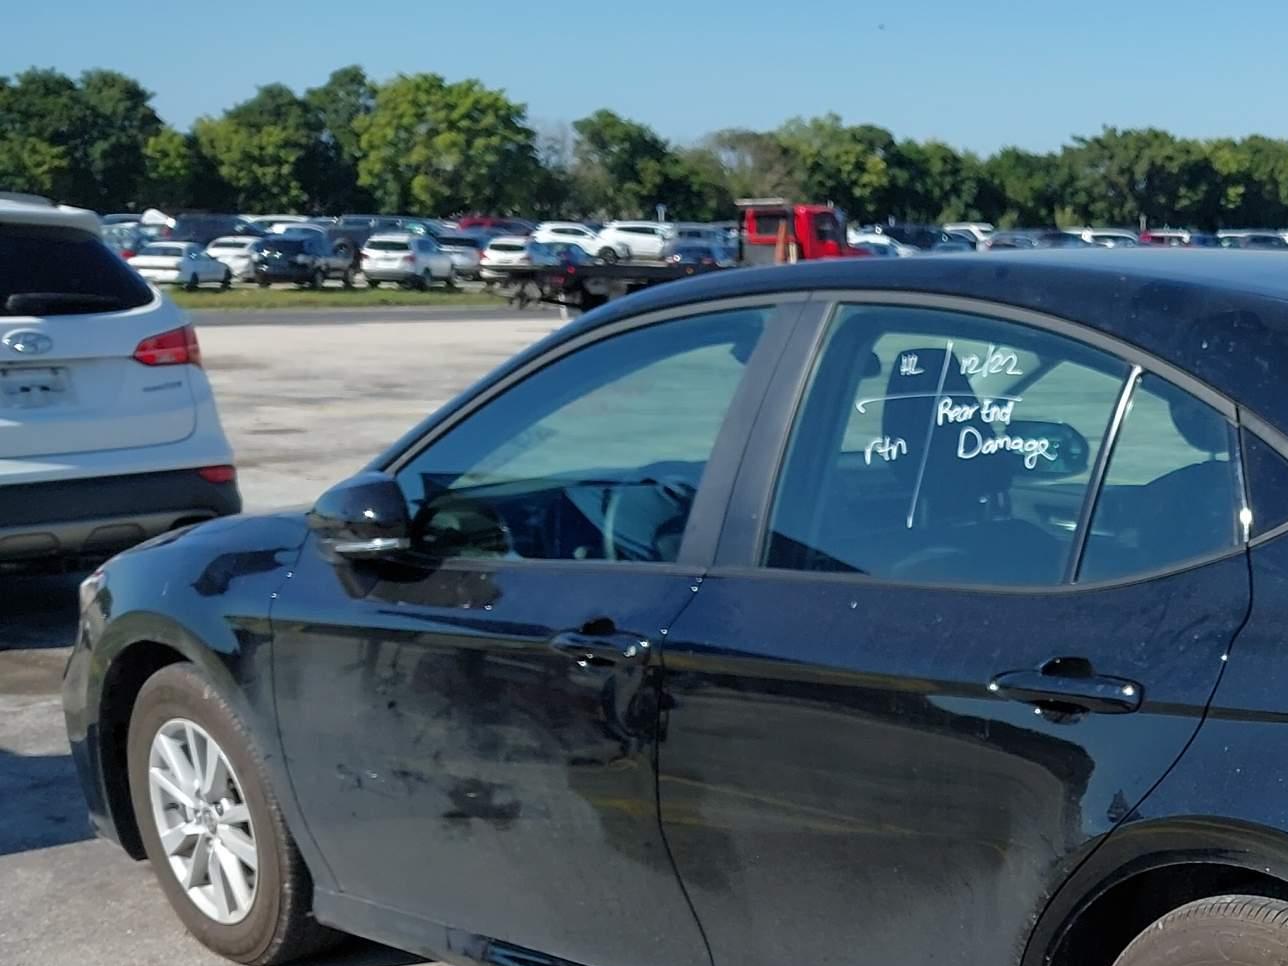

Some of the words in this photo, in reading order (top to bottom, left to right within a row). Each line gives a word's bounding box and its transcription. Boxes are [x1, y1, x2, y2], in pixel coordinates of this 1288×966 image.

[960, 345, 1023, 377] 12/22
[937, 397, 980, 426] Rear
[980, 398, 1015, 425] End
[958, 426, 1058, 470] Damage
